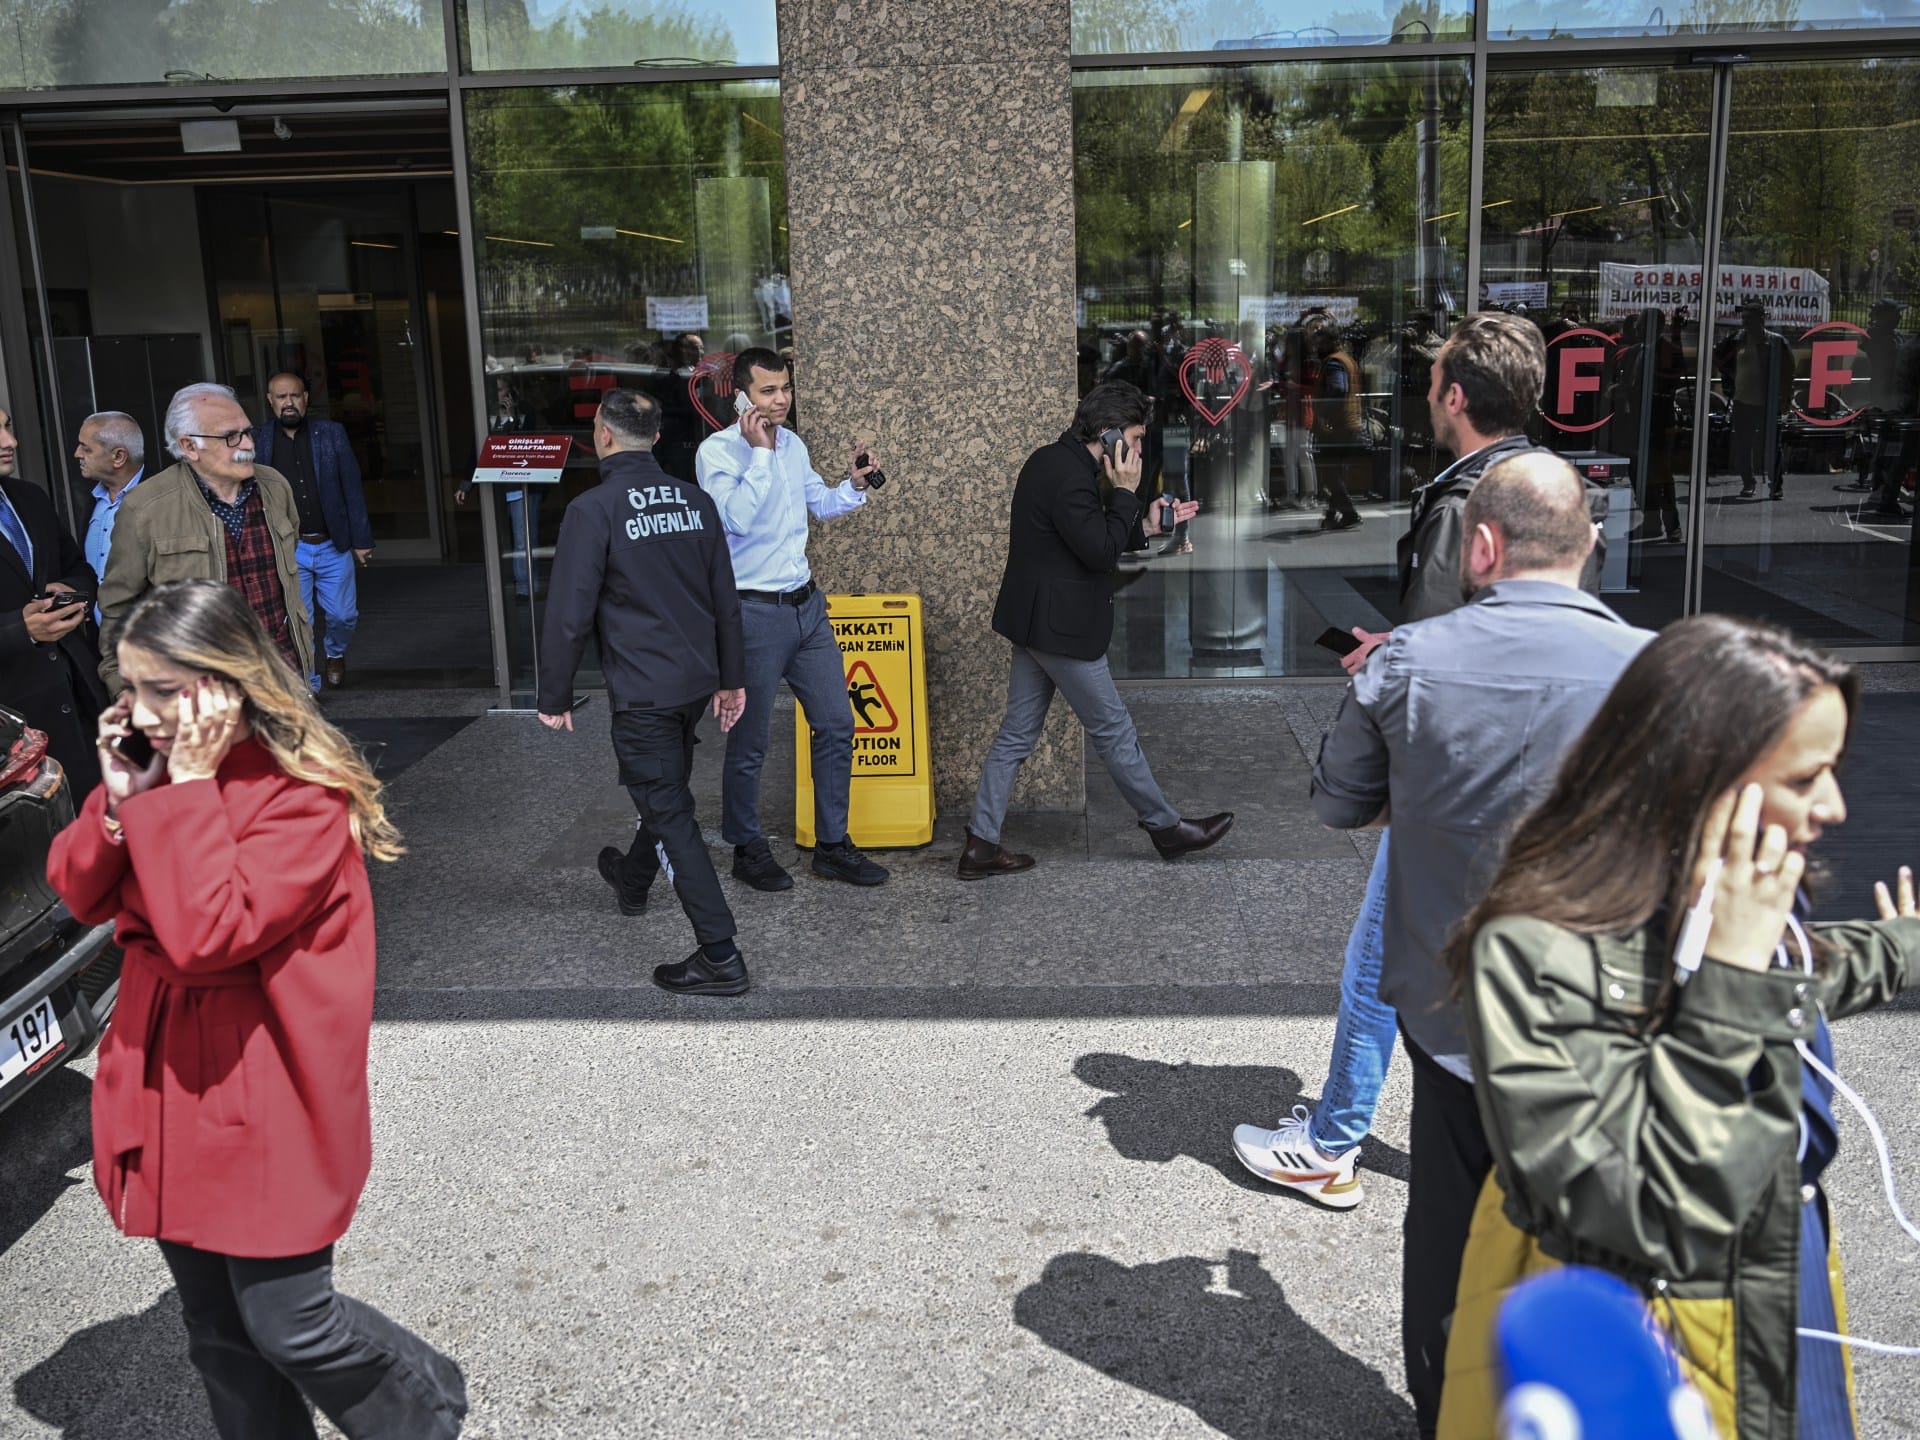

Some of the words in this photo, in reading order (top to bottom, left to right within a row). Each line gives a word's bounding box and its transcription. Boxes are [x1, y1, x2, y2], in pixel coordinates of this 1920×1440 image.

[627, 485, 688, 510] ÖZEL
[625, 506, 704, 540] GÜVENLİK
[830, 622, 893, 636] iKKAT!
[852, 737, 901, 750] UTION
[858, 754, 897, 766] FLOOR
[11, 1002, 49, 1062] 197
